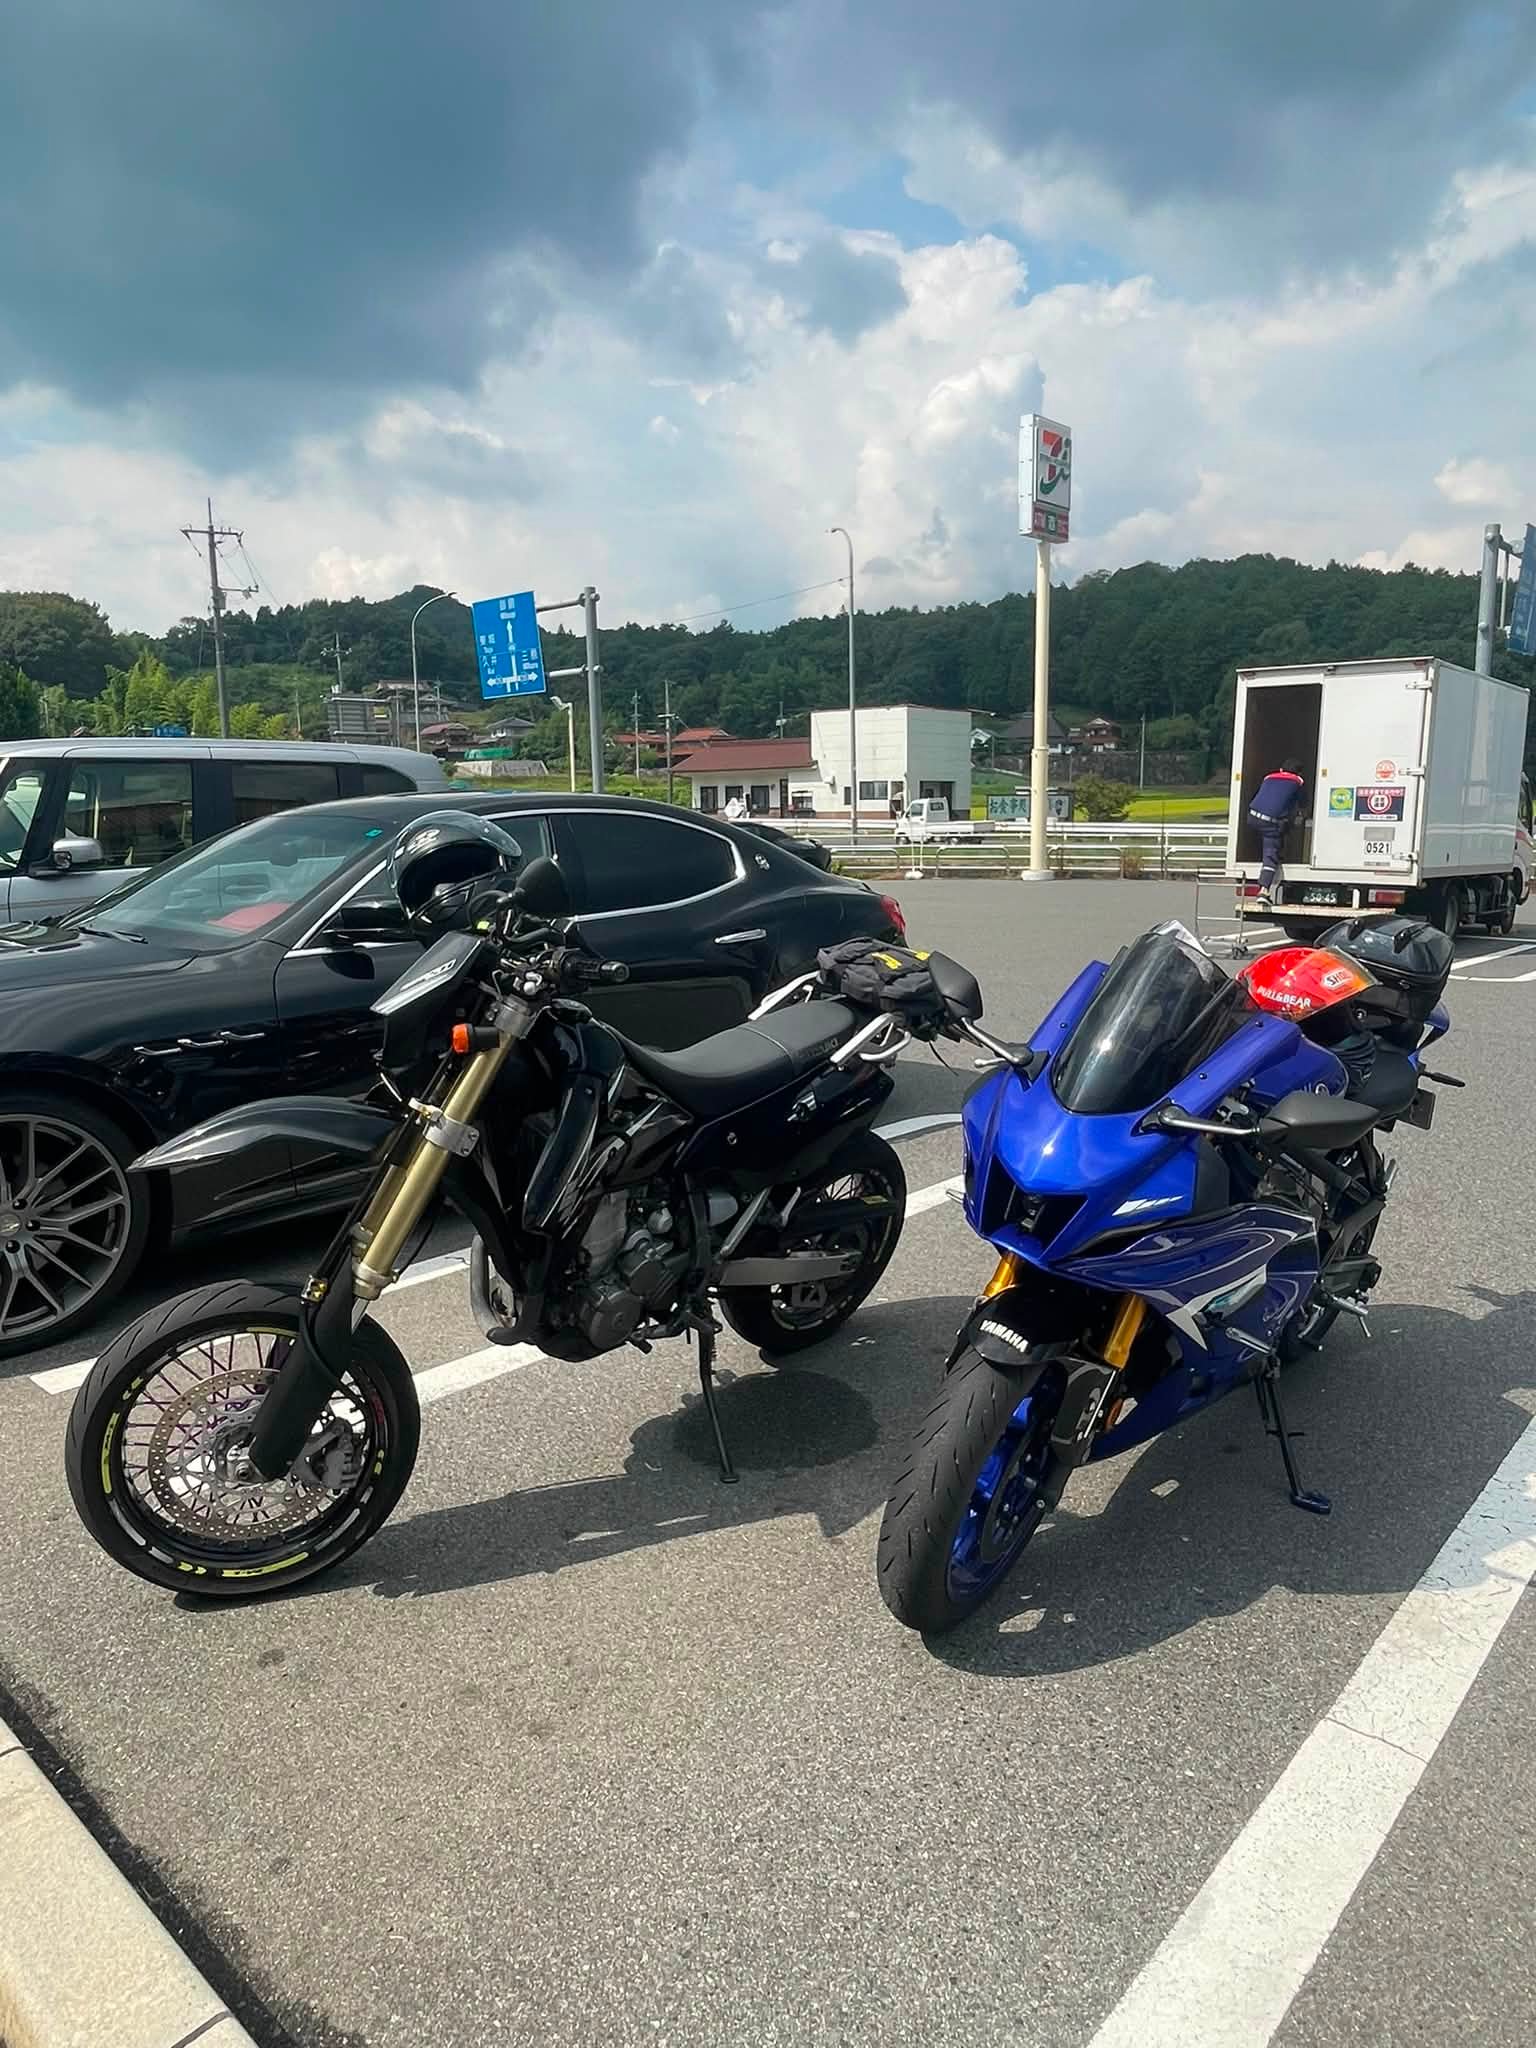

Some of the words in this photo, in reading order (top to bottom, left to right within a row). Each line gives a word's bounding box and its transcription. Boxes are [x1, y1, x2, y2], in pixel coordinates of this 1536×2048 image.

[1366, 842, 1390, 853] 0521
[1257, 986, 1311, 1008] PULL&BEAR
[980, 1320, 1029, 1353] YAMAHA
